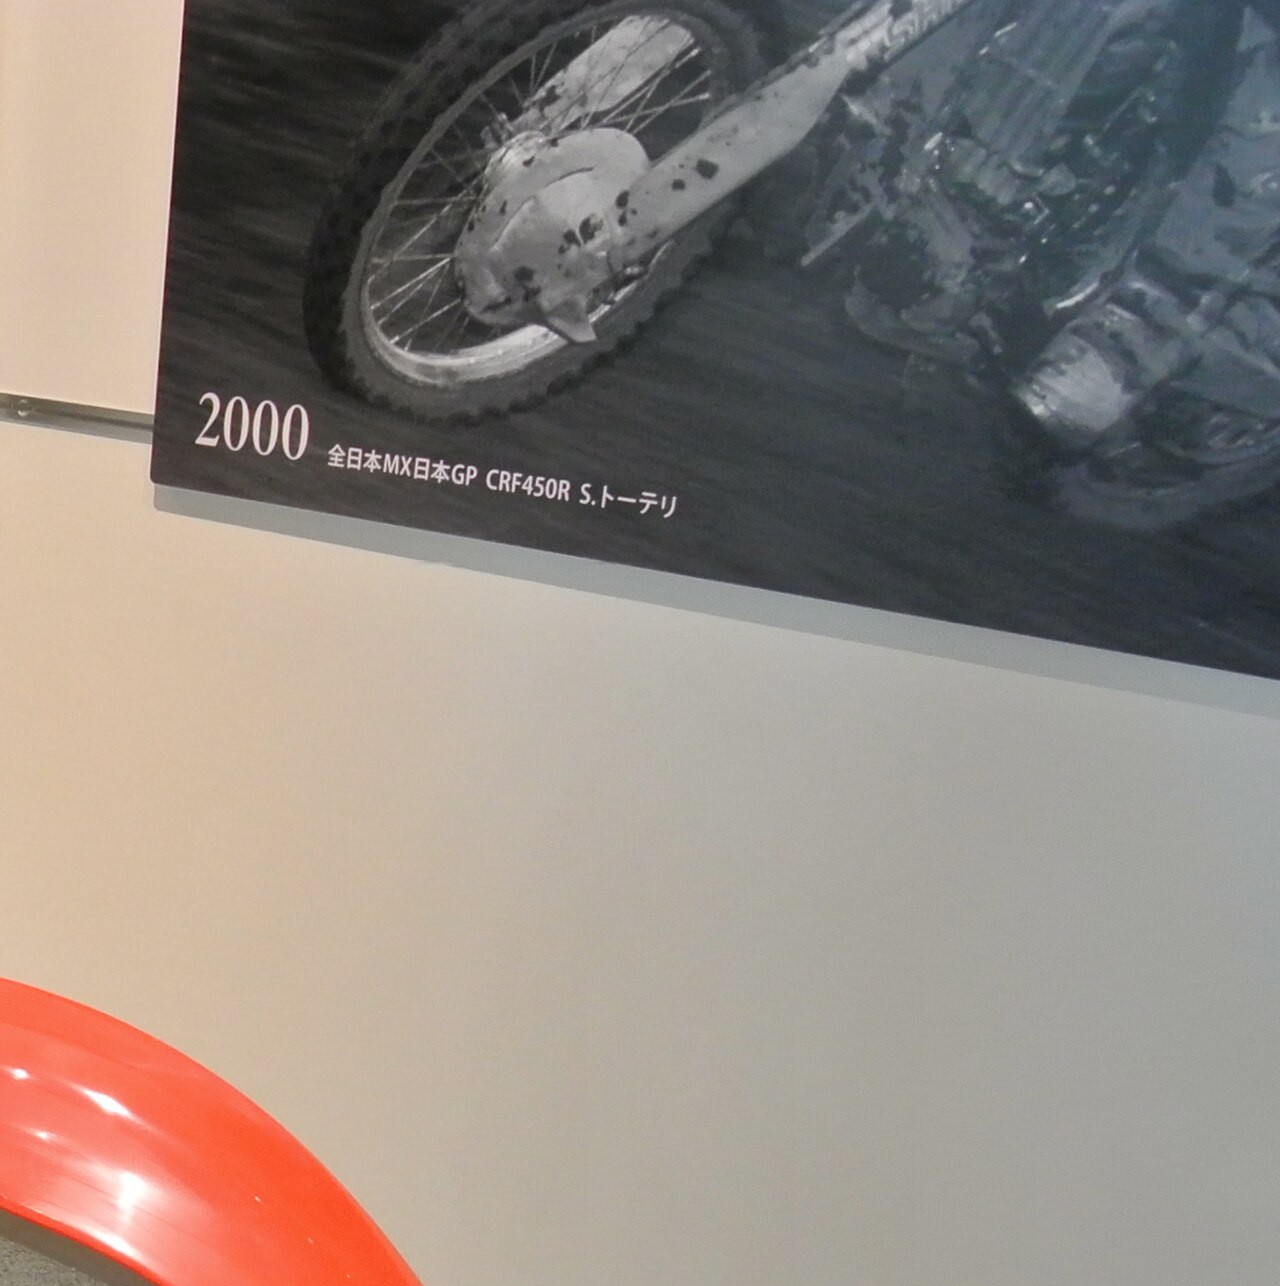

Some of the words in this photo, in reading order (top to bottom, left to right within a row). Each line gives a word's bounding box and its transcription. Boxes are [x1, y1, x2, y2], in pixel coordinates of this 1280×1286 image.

[195, 392, 310, 461] 2000
[328, 444, 478, 488] 全日本MX日本GP
[486, 468, 571, 502] CRF450R
[579, 483, 677, 518] S.トーテリ
